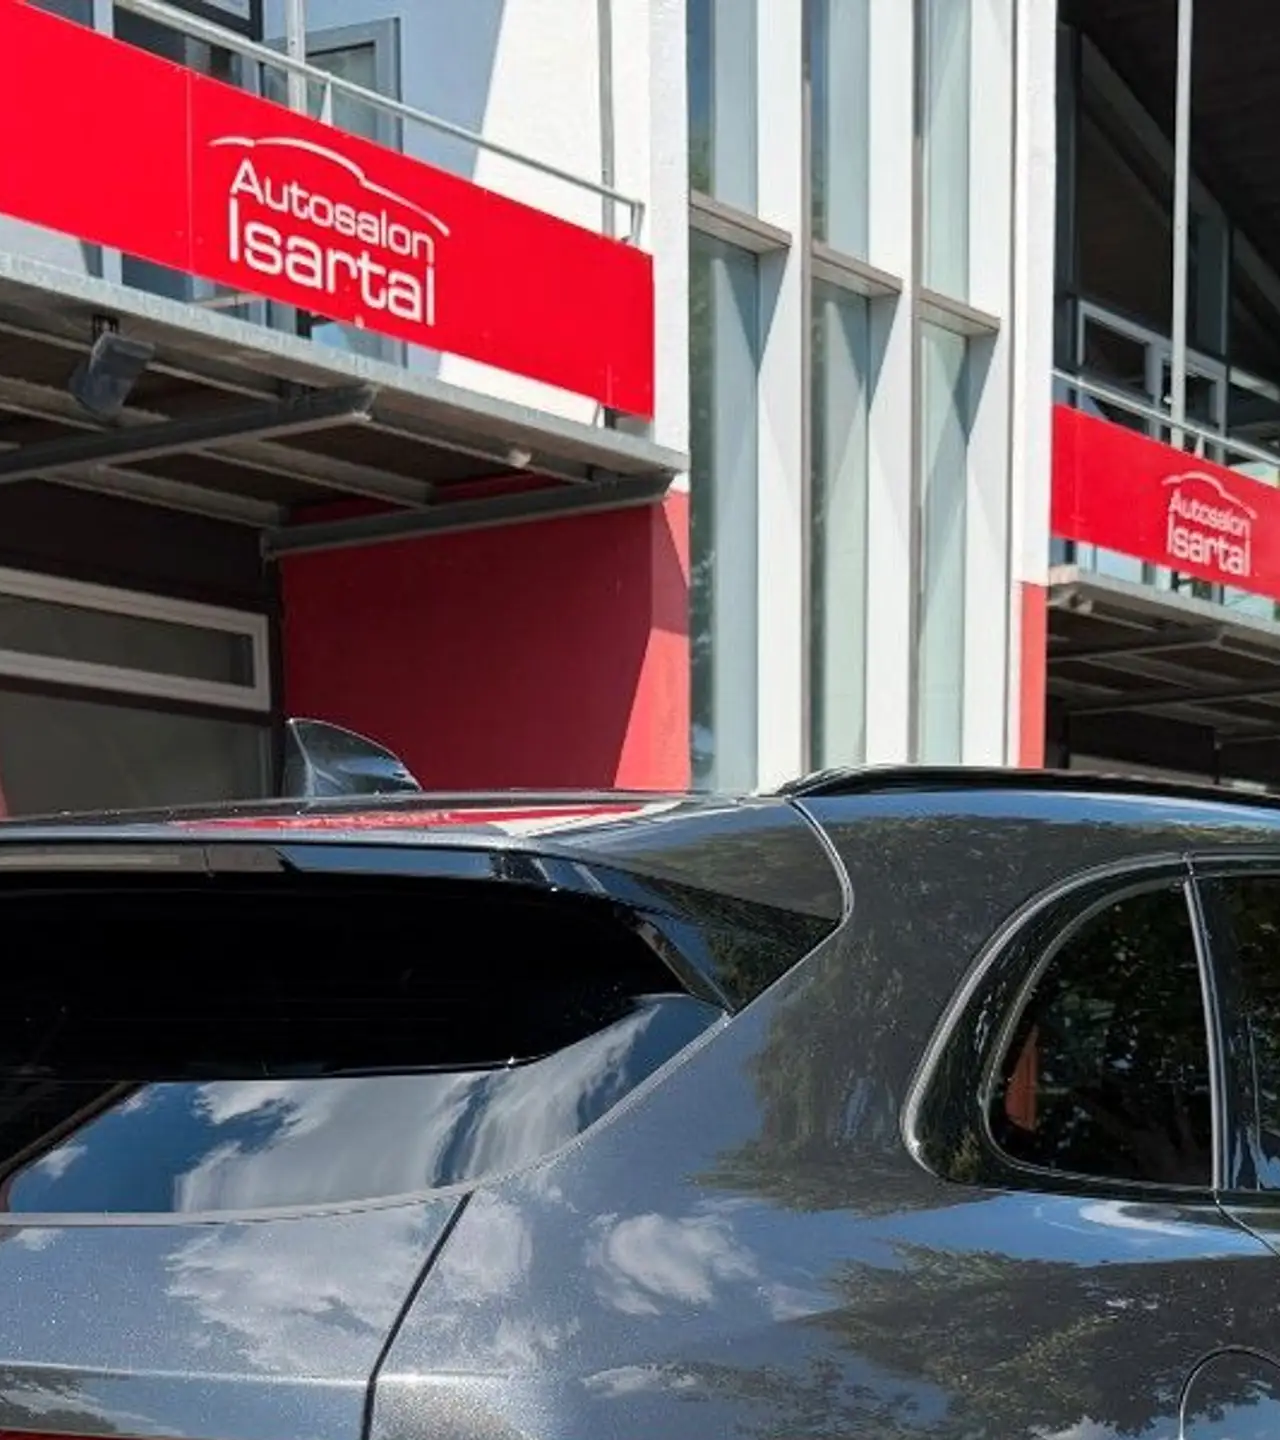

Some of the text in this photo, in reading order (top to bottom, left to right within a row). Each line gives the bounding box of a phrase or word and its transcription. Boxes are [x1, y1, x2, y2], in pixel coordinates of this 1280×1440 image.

[230, 158, 436, 263] Autosalon
[229, 197, 436, 326] Isartal
[1166, 512, 1251, 577] Isartal
[1168, 488, 1251, 538] Autosalon
